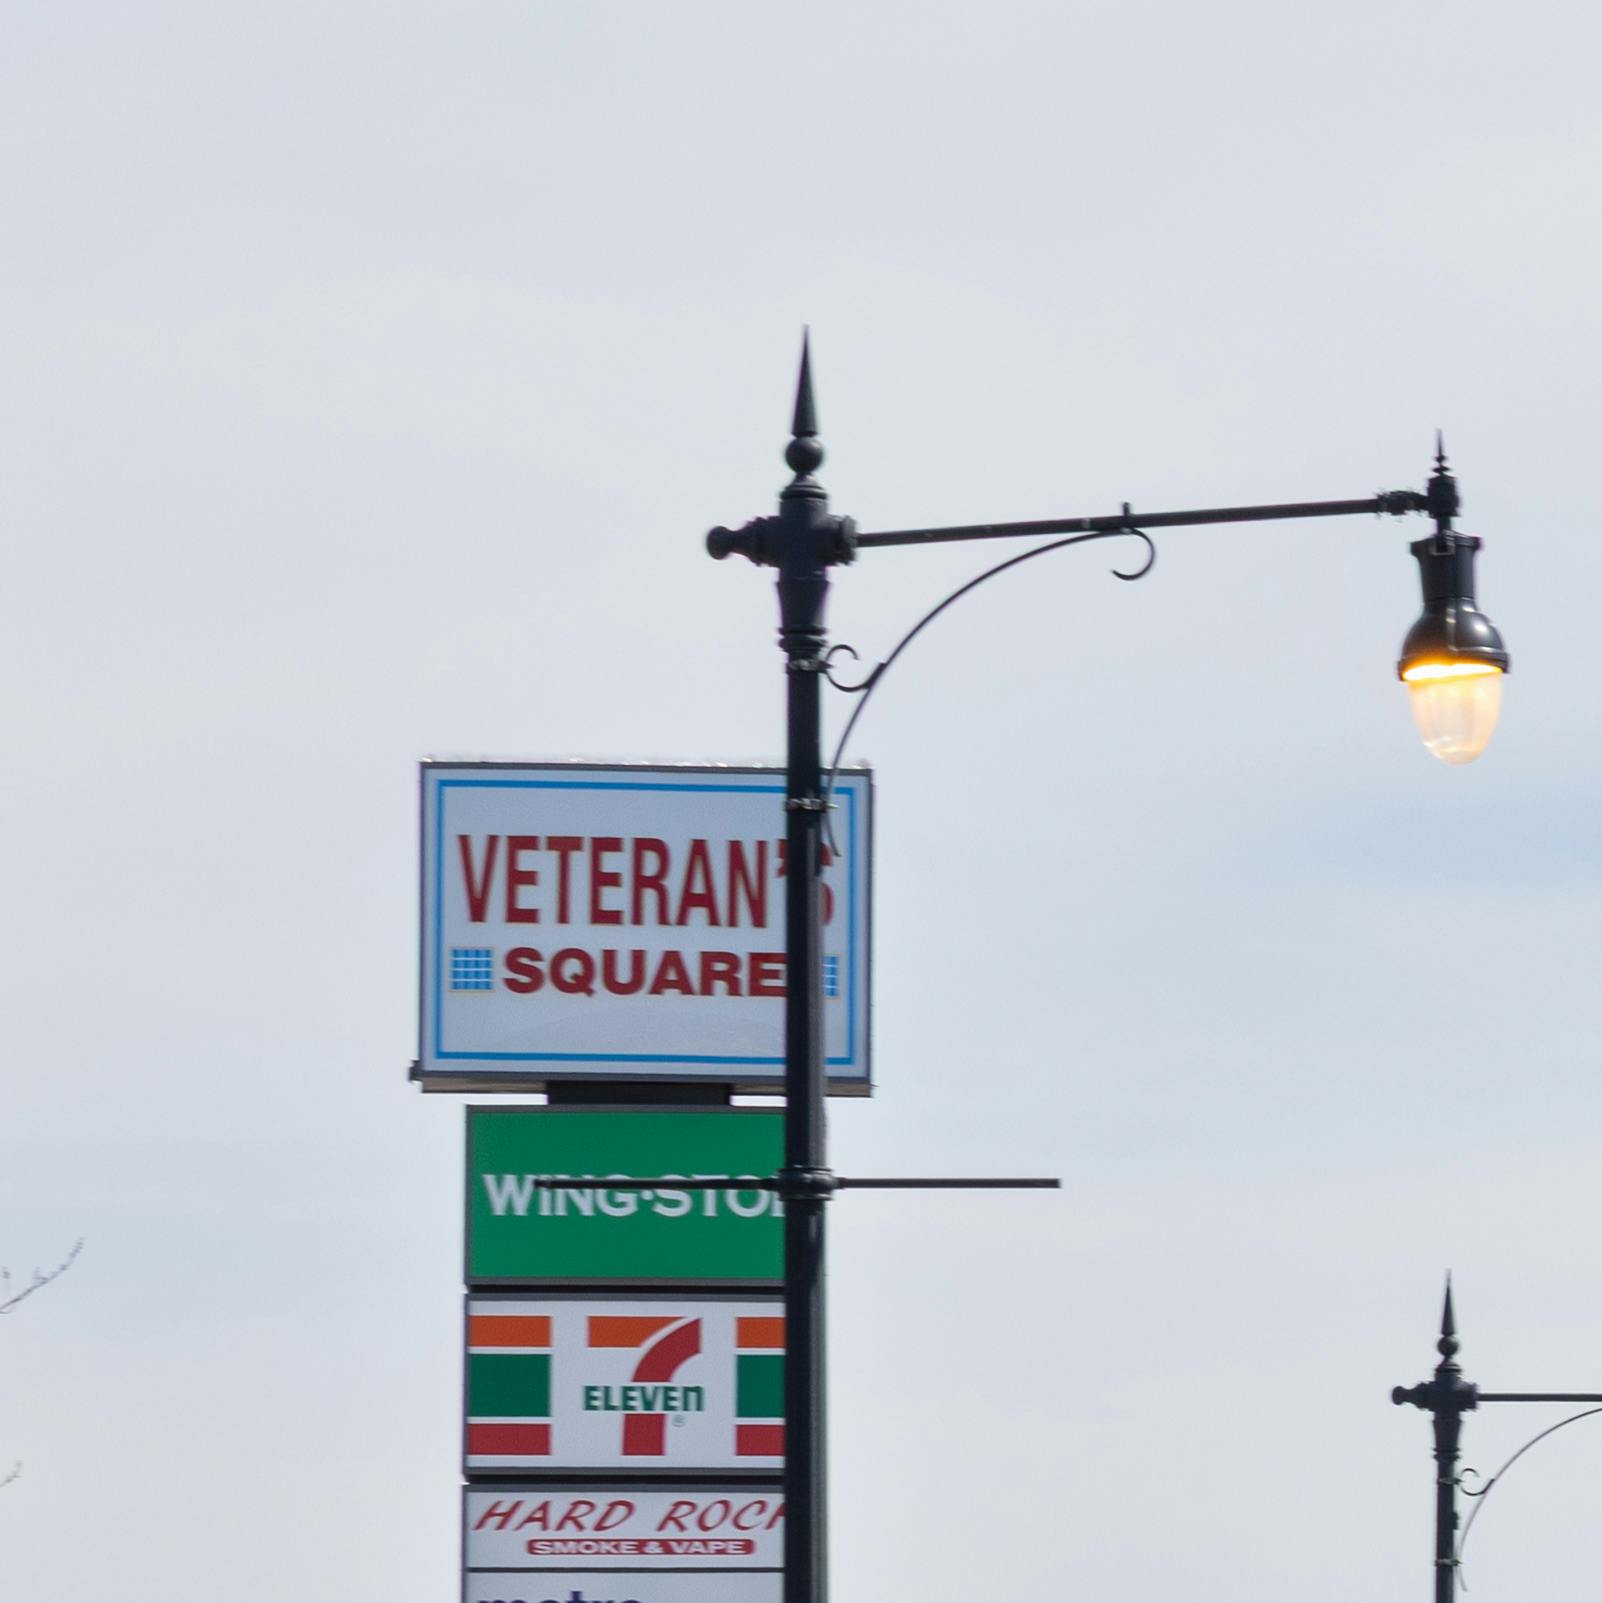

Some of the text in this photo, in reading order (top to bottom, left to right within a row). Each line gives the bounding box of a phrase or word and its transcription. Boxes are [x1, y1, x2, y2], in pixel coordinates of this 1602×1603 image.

[504, 947, 788, 998] SQUARE
[472, 1500, 637, 1532] HARD
[533, 1540, 746, 1554] SMOKE & VAPE
